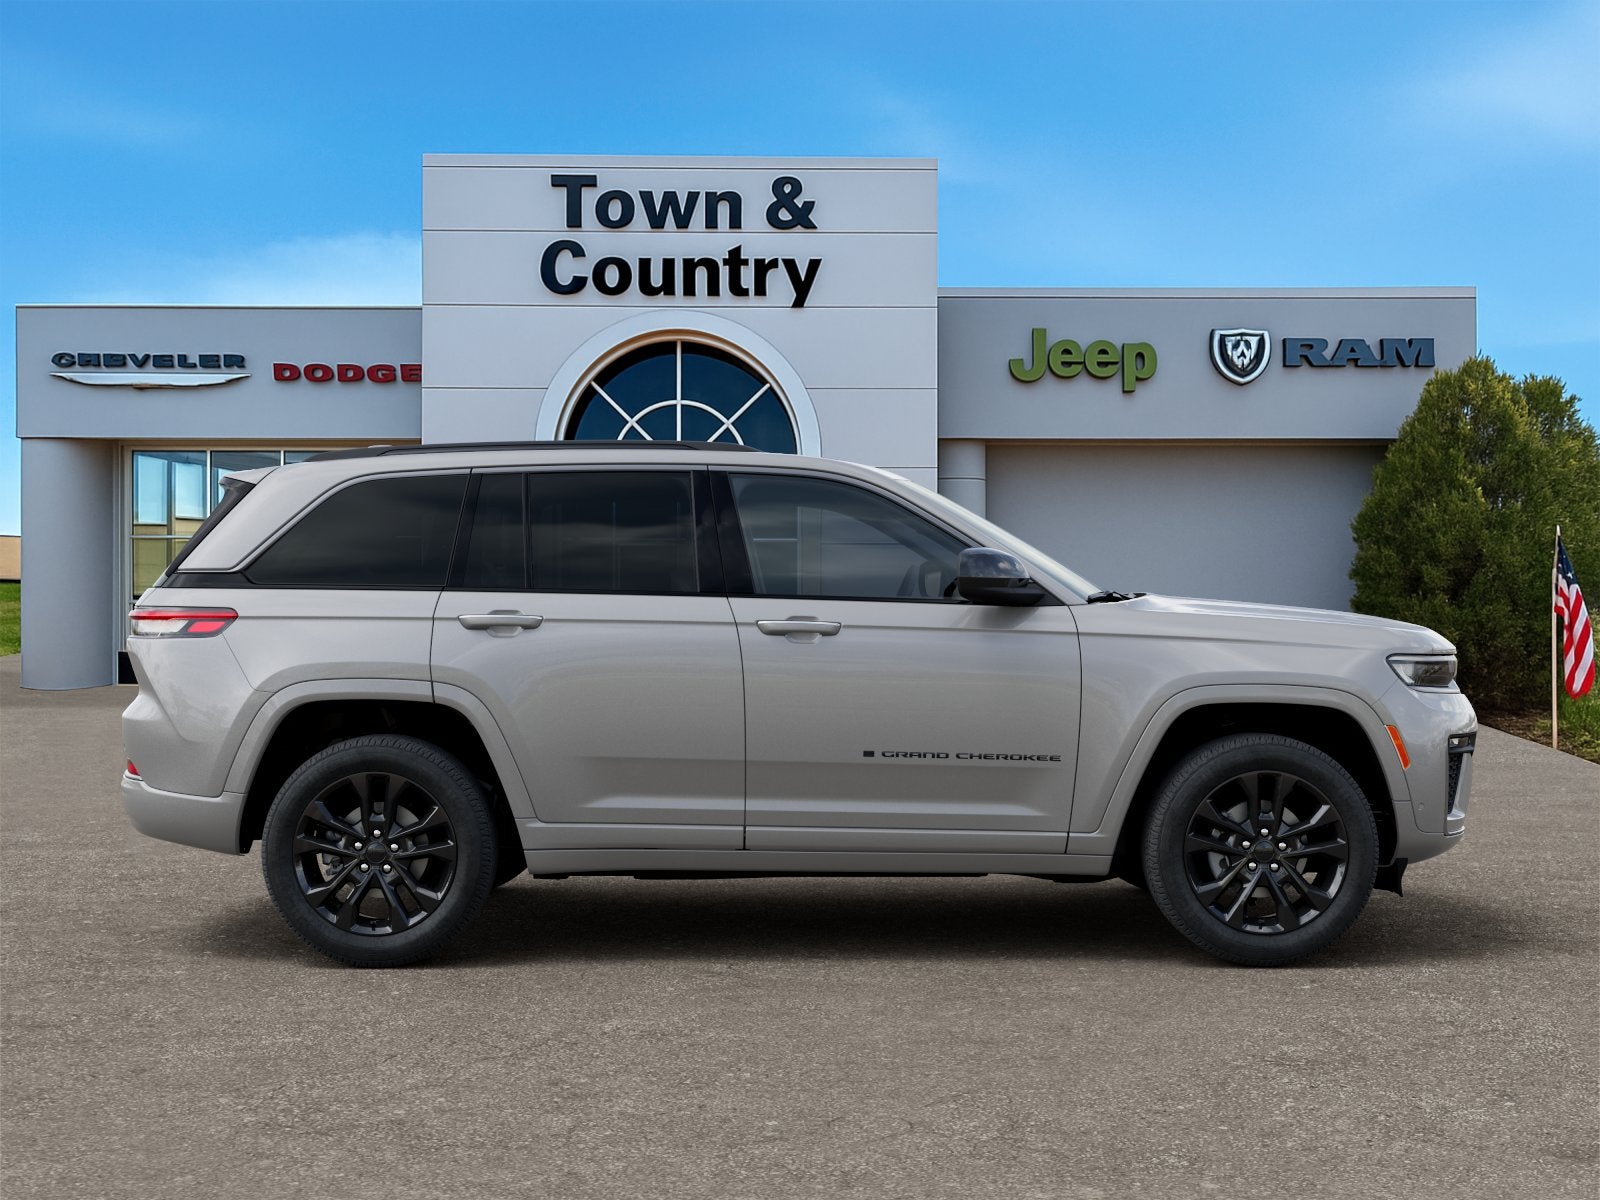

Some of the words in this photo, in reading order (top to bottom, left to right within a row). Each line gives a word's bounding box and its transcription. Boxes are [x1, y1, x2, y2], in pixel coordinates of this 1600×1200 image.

[550, 174, 743, 230] Town
[765, 175, 818, 230] &
[539, 239, 822, 308] Country
[272, 363, 422, 383] DODGE
[1009, 327, 1158, 393] Jeep
[1282, 337, 1436, 368] RAM
[881, 750, 950, 760] GRAND
[955, 752, 1062, 763] CHEROKEE
